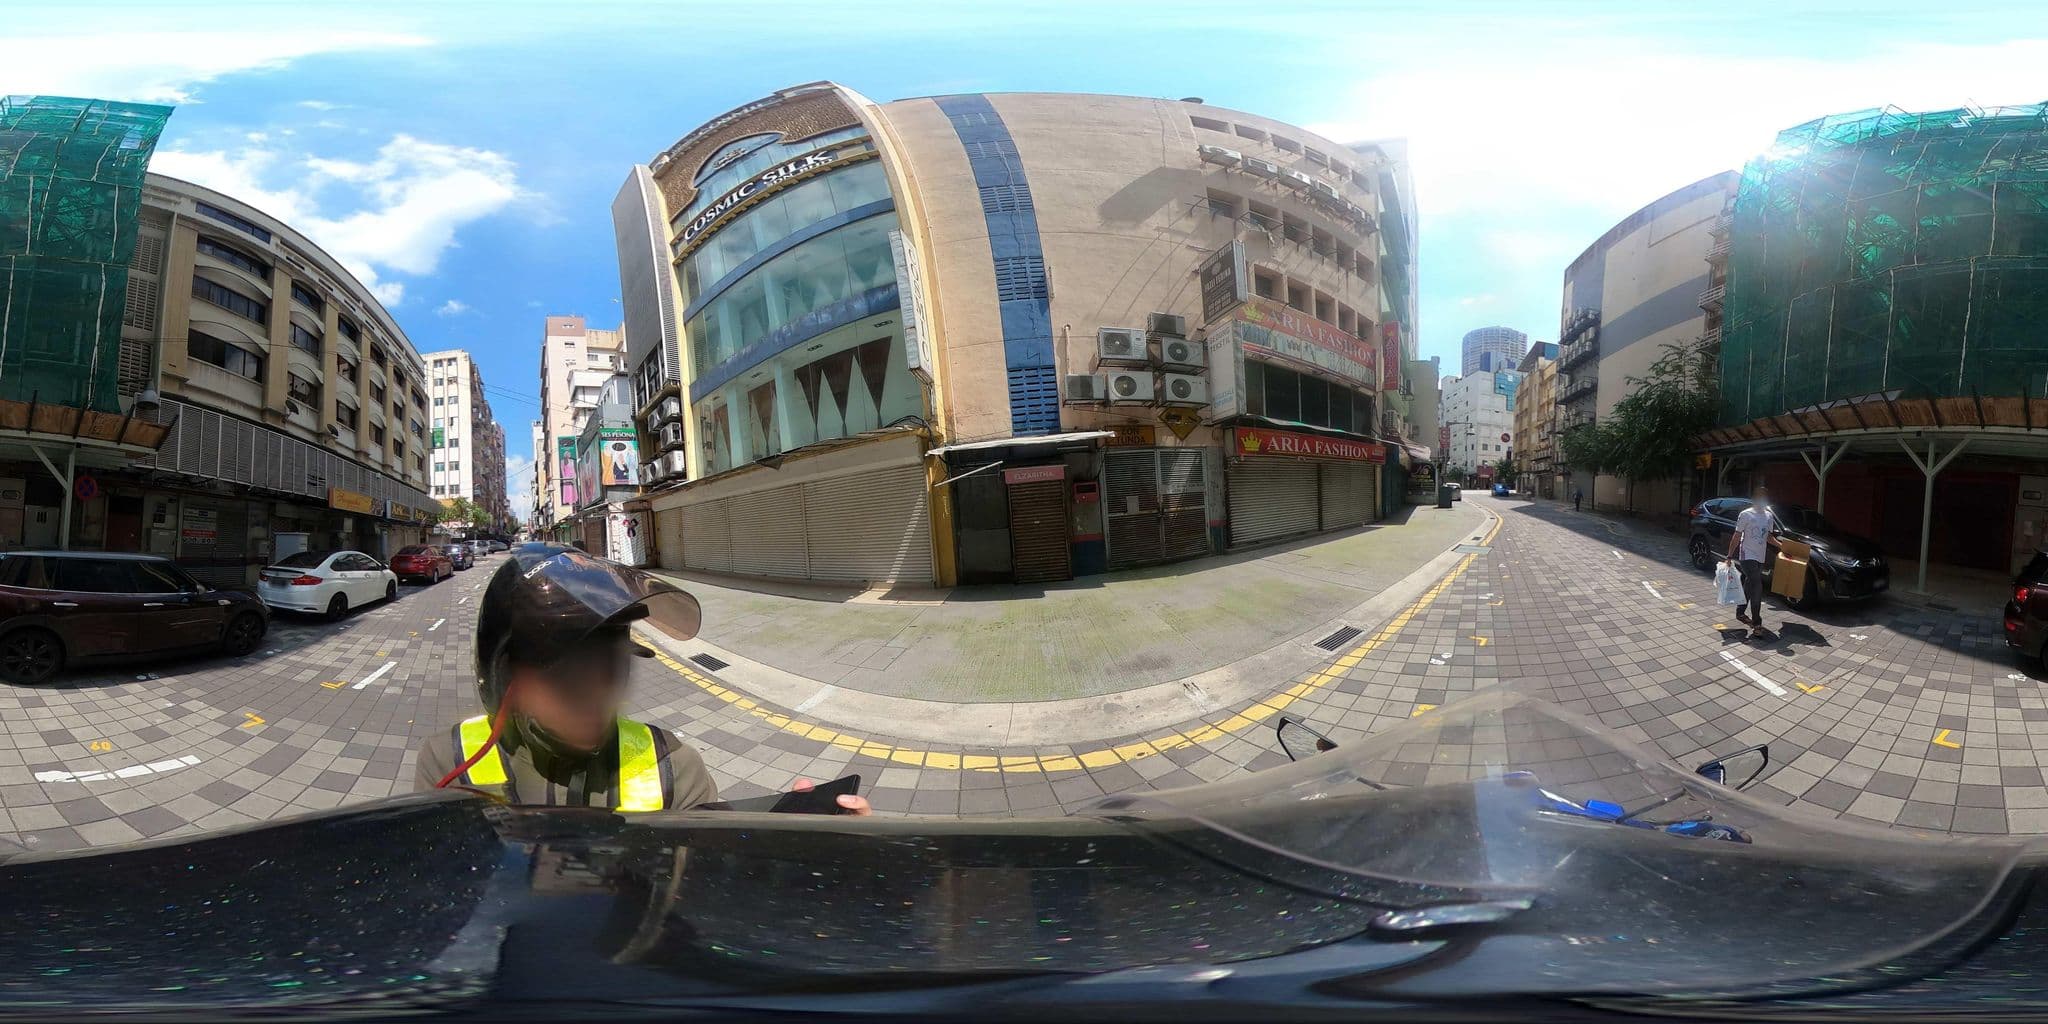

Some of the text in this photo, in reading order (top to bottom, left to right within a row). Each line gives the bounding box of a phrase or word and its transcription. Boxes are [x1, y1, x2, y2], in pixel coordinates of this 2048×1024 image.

[684, 182, 756, 241] COSMIC
[761, 150, 833, 182] SILK
[1267, 310, 1314, 338] ARIA
[1318, 327, 1374, 364] FASHION
[1267, 436, 1311, 453] ARIA
[1315, 441, 1368, 459] FASHION
